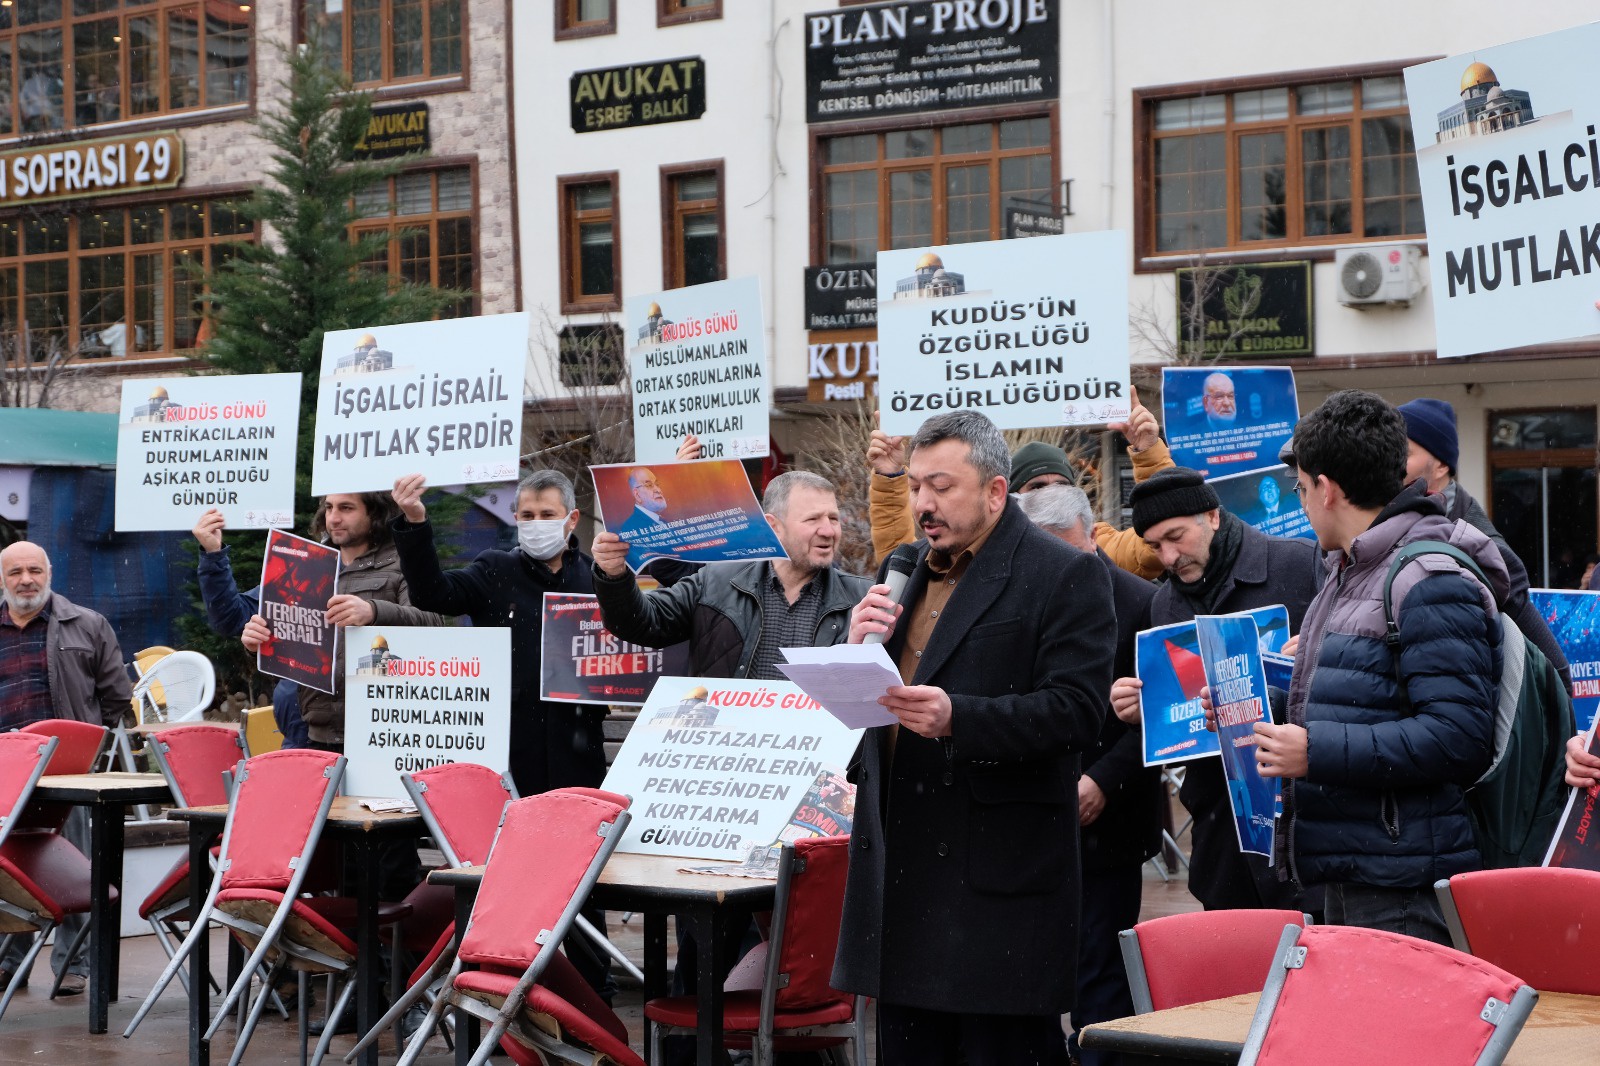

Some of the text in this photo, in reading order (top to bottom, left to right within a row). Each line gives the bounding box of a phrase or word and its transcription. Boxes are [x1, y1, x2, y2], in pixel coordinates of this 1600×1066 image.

[574, 61, 697, 103] AVUKAT
[585, 94, 689, 128] EŞREF BALKİ
[818, 96, 872, 114] KENTSEL
[368, 110, 427, 136] AVUKAT
[13, 143, 127, 197] SOFRASI
[134, 137, 171, 182] 29
[1446, 124, 1600, 220] İŞGALCİ
[1445, 222, 1600, 298] MUTLAK
[846, 296, 877, 312] MÜHE
[931, 296, 1076, 327] KUDÜS'ÜN
[662, 309, 739, 342] KUDÜS GÜNÜ
[811, 313, 852, 327] İNŞAAT
[919, 321, 1090, 355] ÖZGÜRLÜĞÜ
[1241, 335, 1305, 350] BÜROSU
[645, 338, 748, 369] MÜSLÜMANLARIN
[635, 362, 762, 394] ORTAK SORUNLARINA
[945, 356, 1064, 381] İSLAMIN
[334, 367, 509, 419] İŞGALCİ İSRAİL
[639, 387, 761, 418] ORTAK SORUMLULUK
[825, 381, 865, 400] Pestil
[891, 377, 1123, 412] ÖZGÜRLÜĞÜDÜR
[166, 400, 267, 421] KUDÜS GÜNÜ
[141, 425, 275, 443] ENTRİKACILARIN
[323, 412, 514, 462] MUTLAK ŞERDİR
[656, 415, 743, 440] KUŞANDIKLARI
[146, 447, 268, 464] DURUMLARININ
[142, 466, 270, 486] AŞİKAR OLDUĞU
[172, 488, 238, 506] GÜNDÜR
[387, 656, 481, 677] KUDÜS GÜNÜ
[571, 652, 663, 677] TERK ET!
[367, 681, 490, 702] ENTRİKACILARIN
[614, 687, 645, 695] SAADET
[707, 688, 778, 709] KUDÜS
[371, 708, 484, 726] DURUMLARININ
[368, 728, 485, 750] AŞİKAR OLDUĞU
[661, 729, 822, 752] MUSTAZAFLARI
[637, 748, 822, 777] MÜSTEKBİRLERİN
[642, 777, 791, 801] PENÇESİNDEN
[644, 802, 760, 826] KURTARMA
[1575, 796, 1596, 845] SAADET
[640, 825, 742, 851] GÜNÜDÜR
